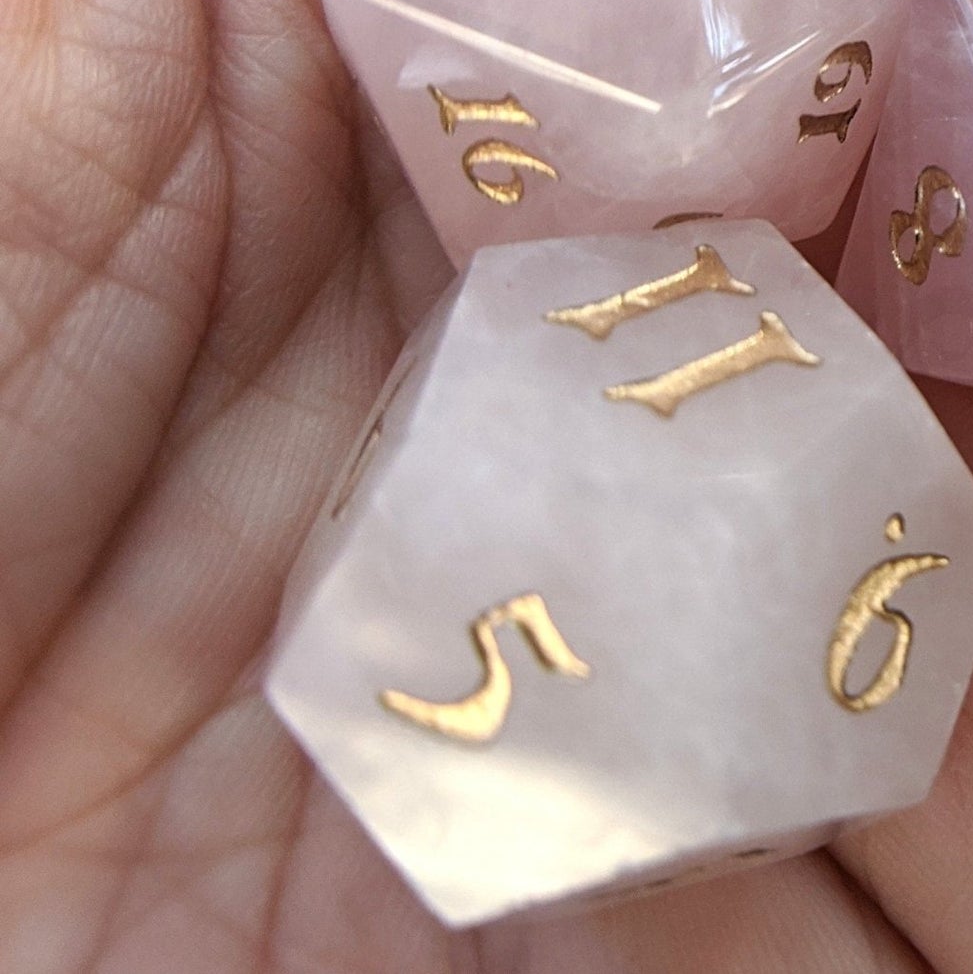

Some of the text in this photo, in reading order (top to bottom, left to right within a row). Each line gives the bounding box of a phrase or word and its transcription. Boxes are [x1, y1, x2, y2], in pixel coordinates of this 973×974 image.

[888, 164, 967, 286] 8
[544, 244, 823, 418] 11
[379, 592, 592, 748] 5
